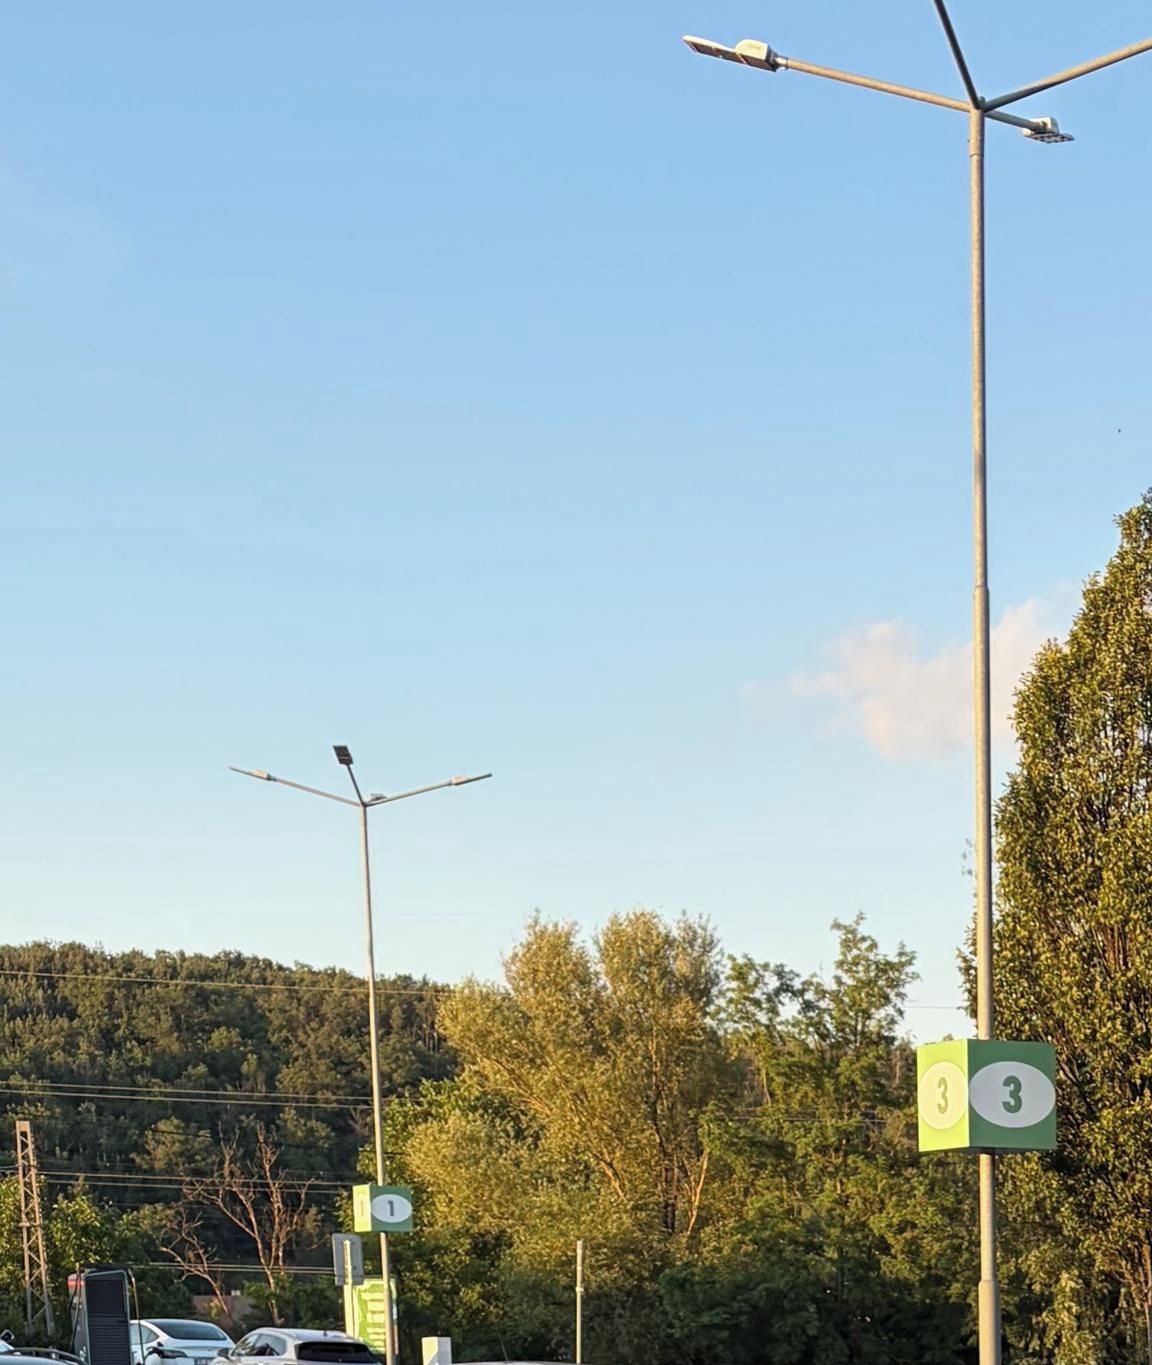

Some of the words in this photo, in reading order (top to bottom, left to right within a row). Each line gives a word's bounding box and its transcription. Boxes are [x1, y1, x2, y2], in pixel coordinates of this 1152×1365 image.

[937, 1076, 949, 1115] 3
[1001, 1075, 1023, 1114] 3
[387, 1199, 395, 1217] 1
